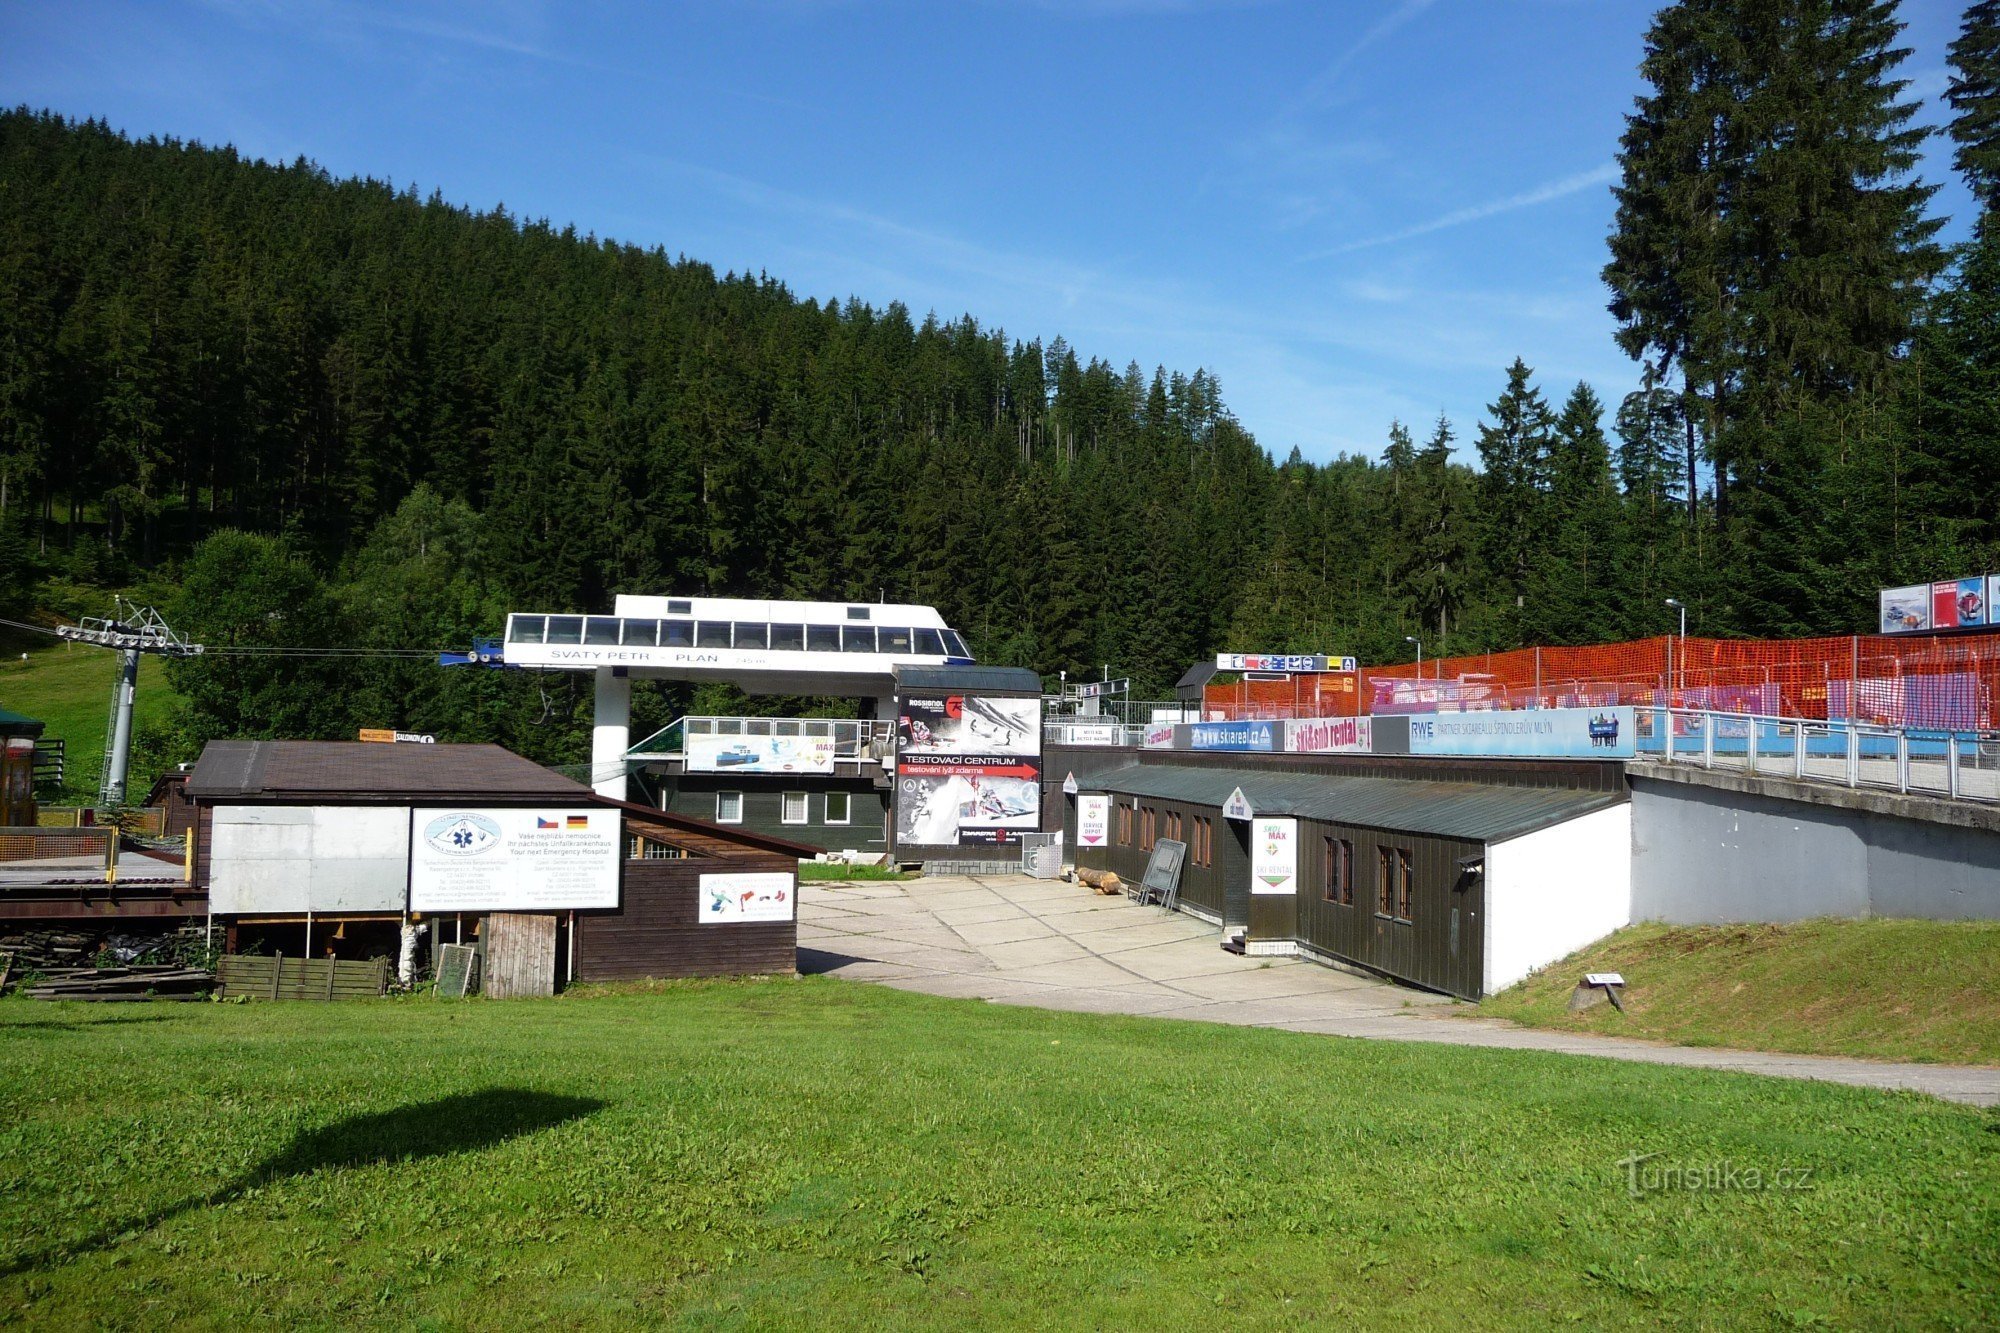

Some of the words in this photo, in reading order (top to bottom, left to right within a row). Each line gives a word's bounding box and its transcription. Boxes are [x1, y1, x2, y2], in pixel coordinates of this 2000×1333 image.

[607, 651, 649, 661] PETR
[1330, 718, 1356, 747] rental
[1412, 722, 1433, 735] RWE
[906, 755, 962, 764] TESTOVACÍ
[965, 757, 1016, 765] CENTRUM
[1268, 832, 1287, 840] MAX
